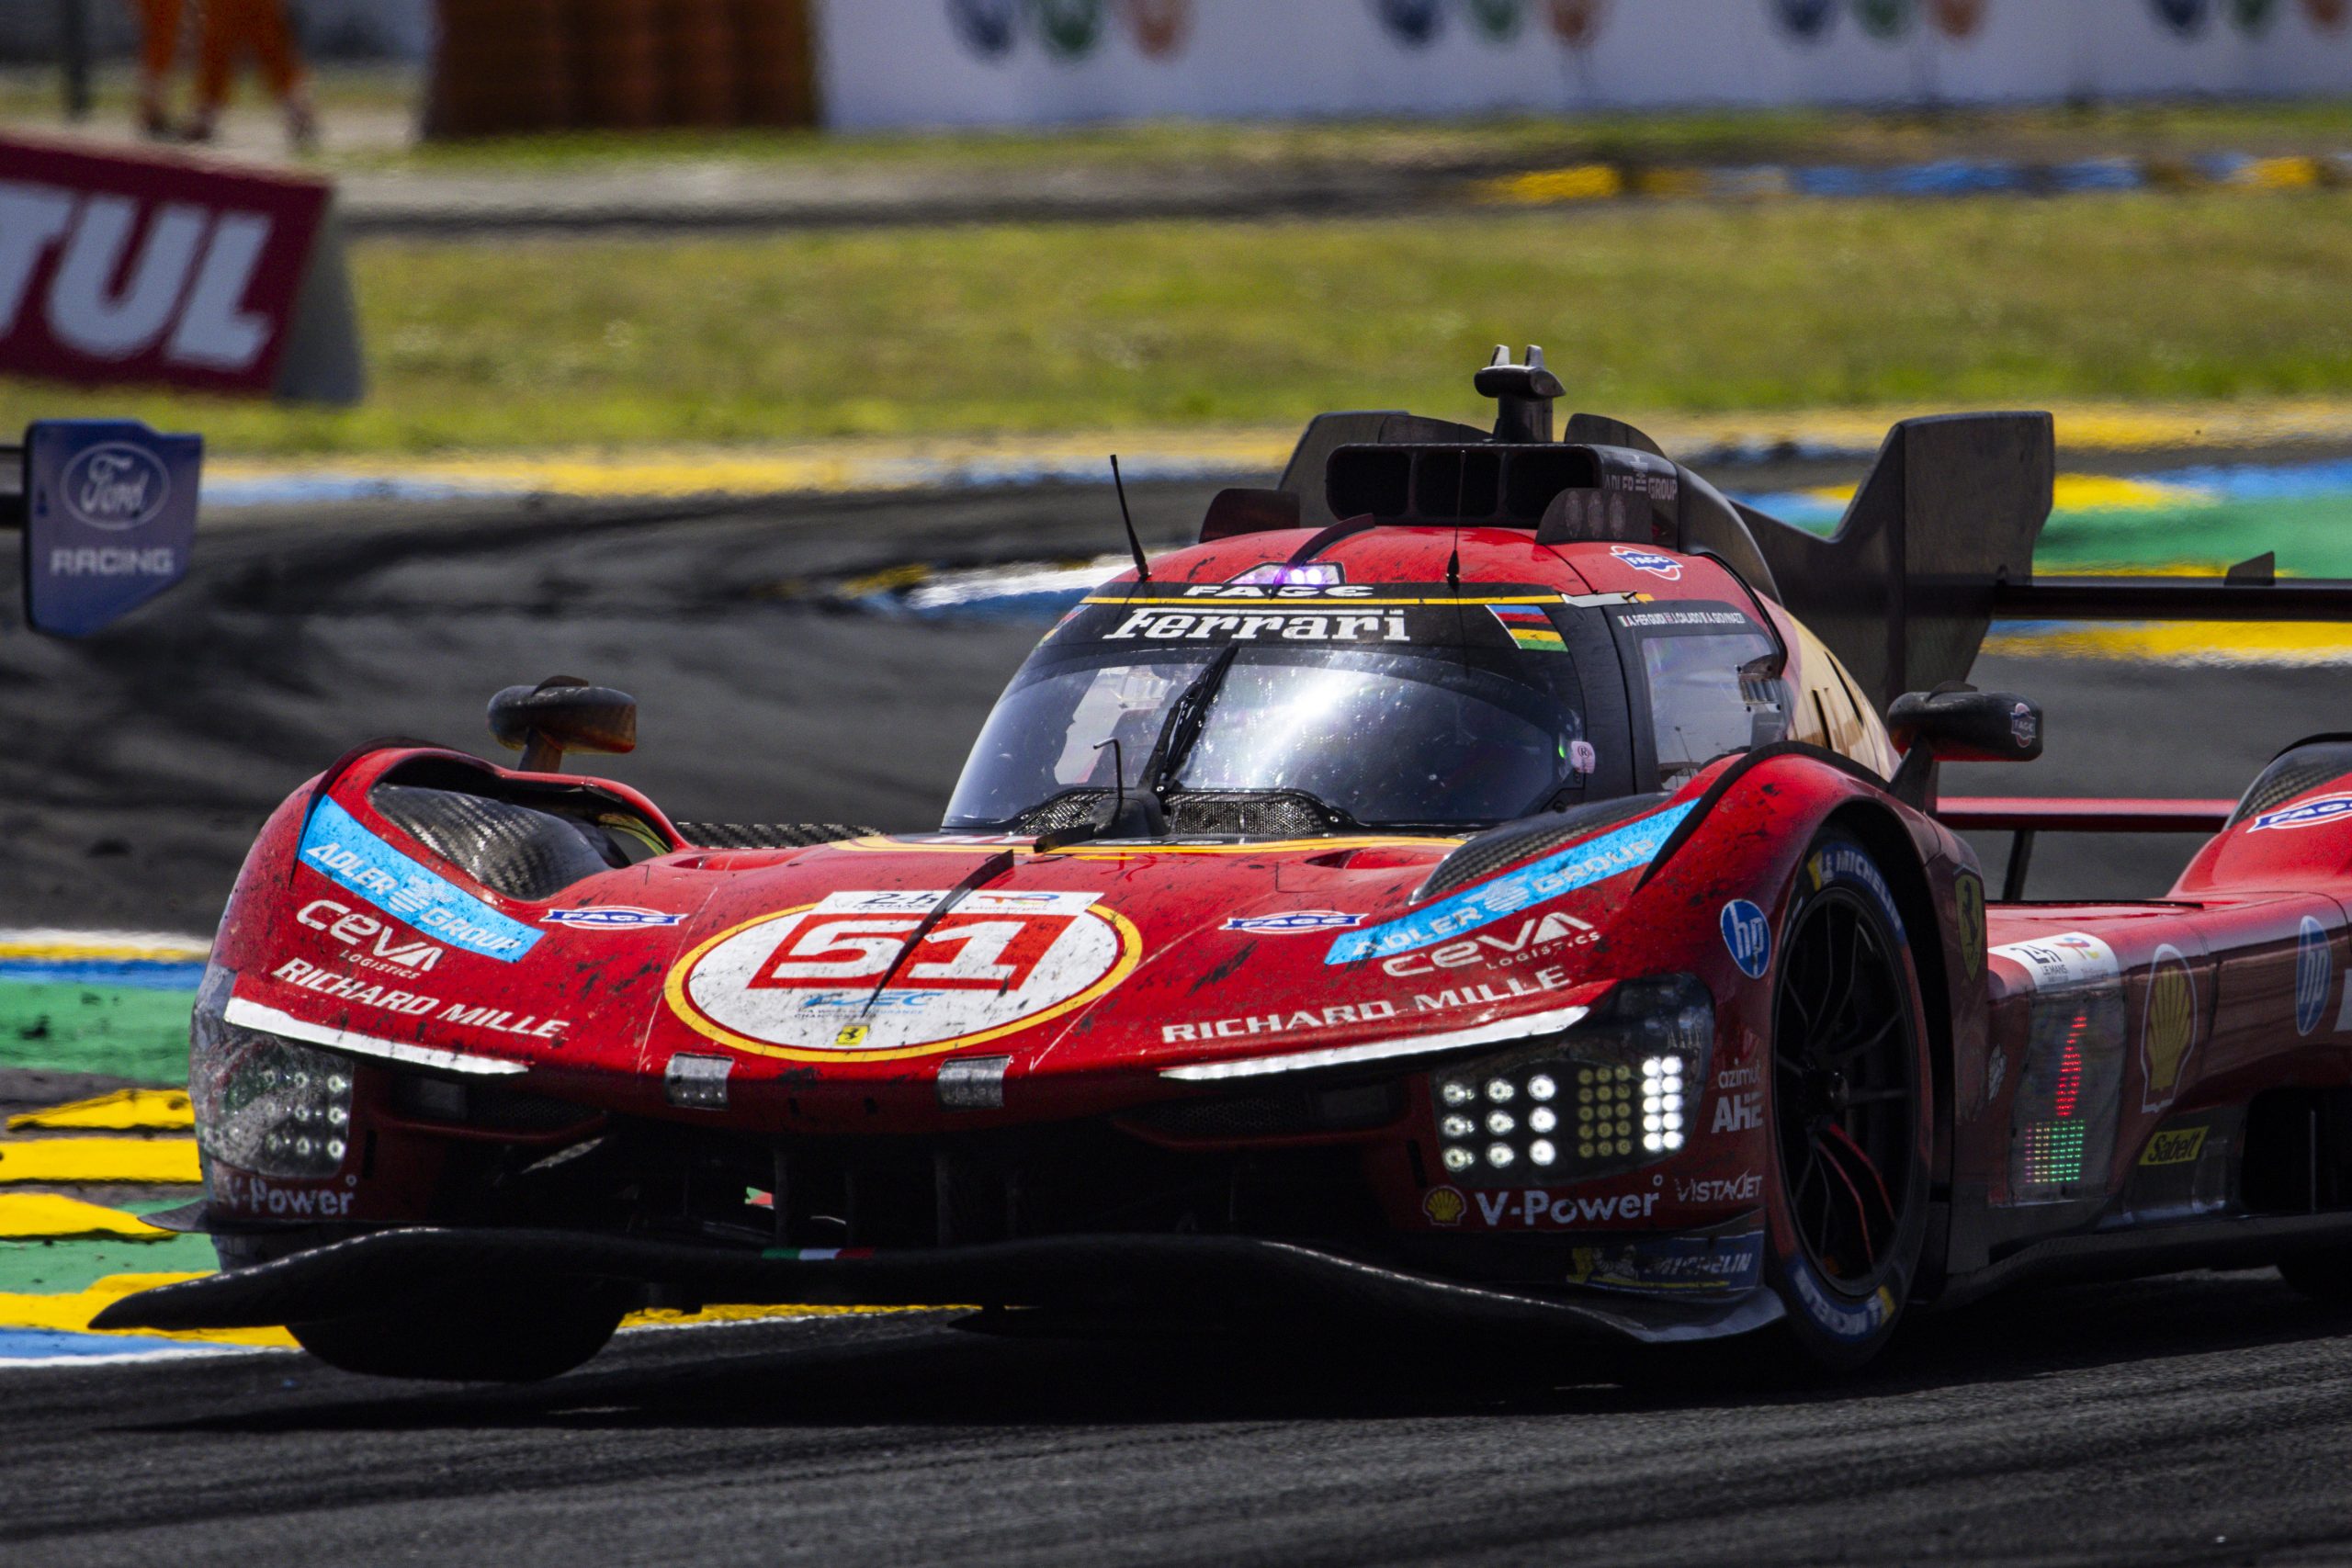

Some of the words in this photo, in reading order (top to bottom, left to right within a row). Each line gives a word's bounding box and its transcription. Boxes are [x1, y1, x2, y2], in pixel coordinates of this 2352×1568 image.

[80, 453, 150, 513] Ford
[1648, 477, 1678, 500] GROUP
[50, 548, 175, 576] RACING
[1102, 607, 1411, 641] Ferrari
[2267, 803, 2352, 824] FAG
[306, 842, 398, 896] ADLER
[420, 908, 522, 951] GROUP
[1351, 907, 1484, 956] ADLER
[1532, 839, 1654, 894] GROUP
[772, 920, 1030, 981] 51
[1729, 901, 1764, 976] hp
[340, 950, 422, 980] LOGISTICS
[2300, 917, 2328, 1029] hp
[271, 957, 440, 1015] RICHARD
[436, 1003, 570, 1039] MILLE
[1161, 1000, 1394, 1043] RICHARD
[1415, 965, 1572, 1011] MILLE
[1718, 1057, 1761, 1089] azimut
[2148, 1131, 2201, 1162] Sabelt
[1476, 1190, 1657, 1226] V-Power
